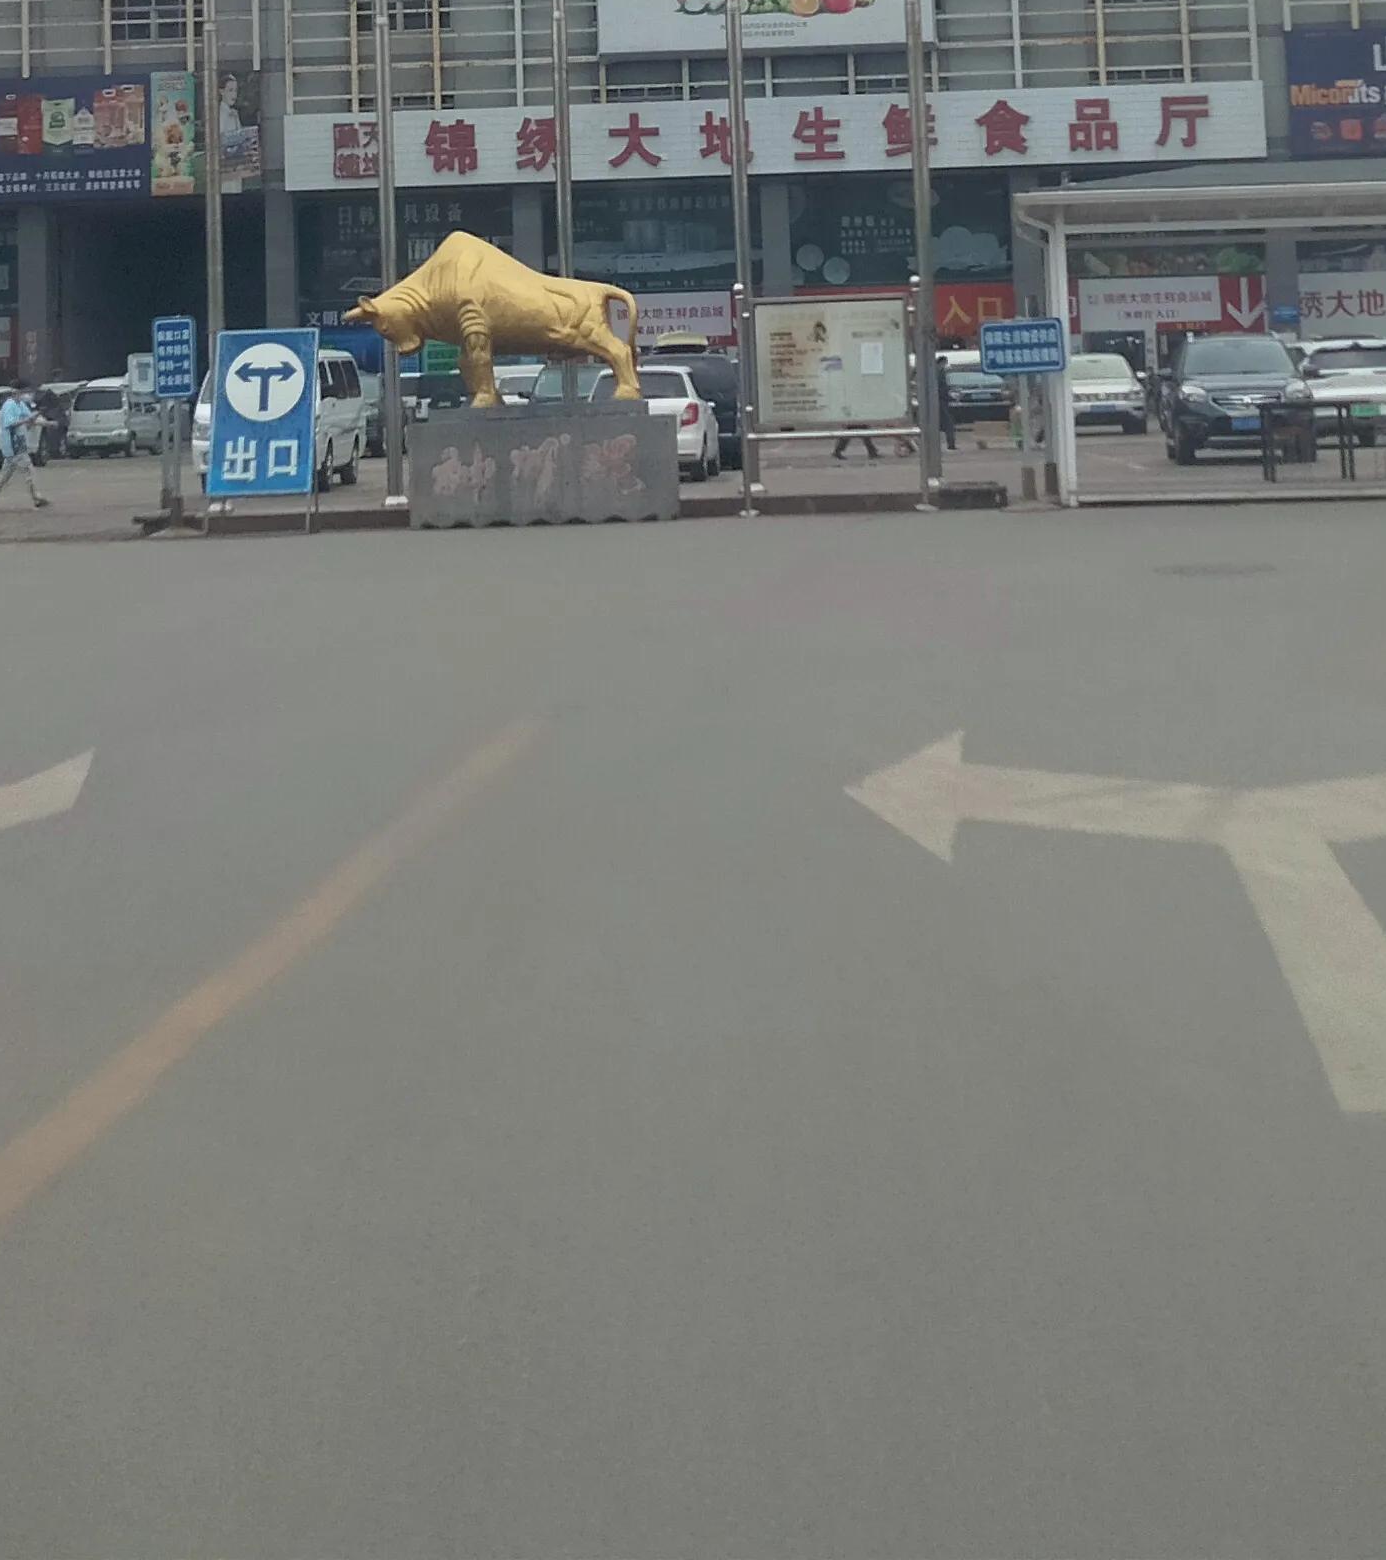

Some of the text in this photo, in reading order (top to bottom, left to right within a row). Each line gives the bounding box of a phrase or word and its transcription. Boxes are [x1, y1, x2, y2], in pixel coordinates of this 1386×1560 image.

[425, 95, 1210, 175] 锦绣大地生鲜食品厅
[616, 306, 724, 321] 锦大地生鲜食品城
[942, 294, 1003, 325] 入口
[221, 435, 299, 482] 出口
